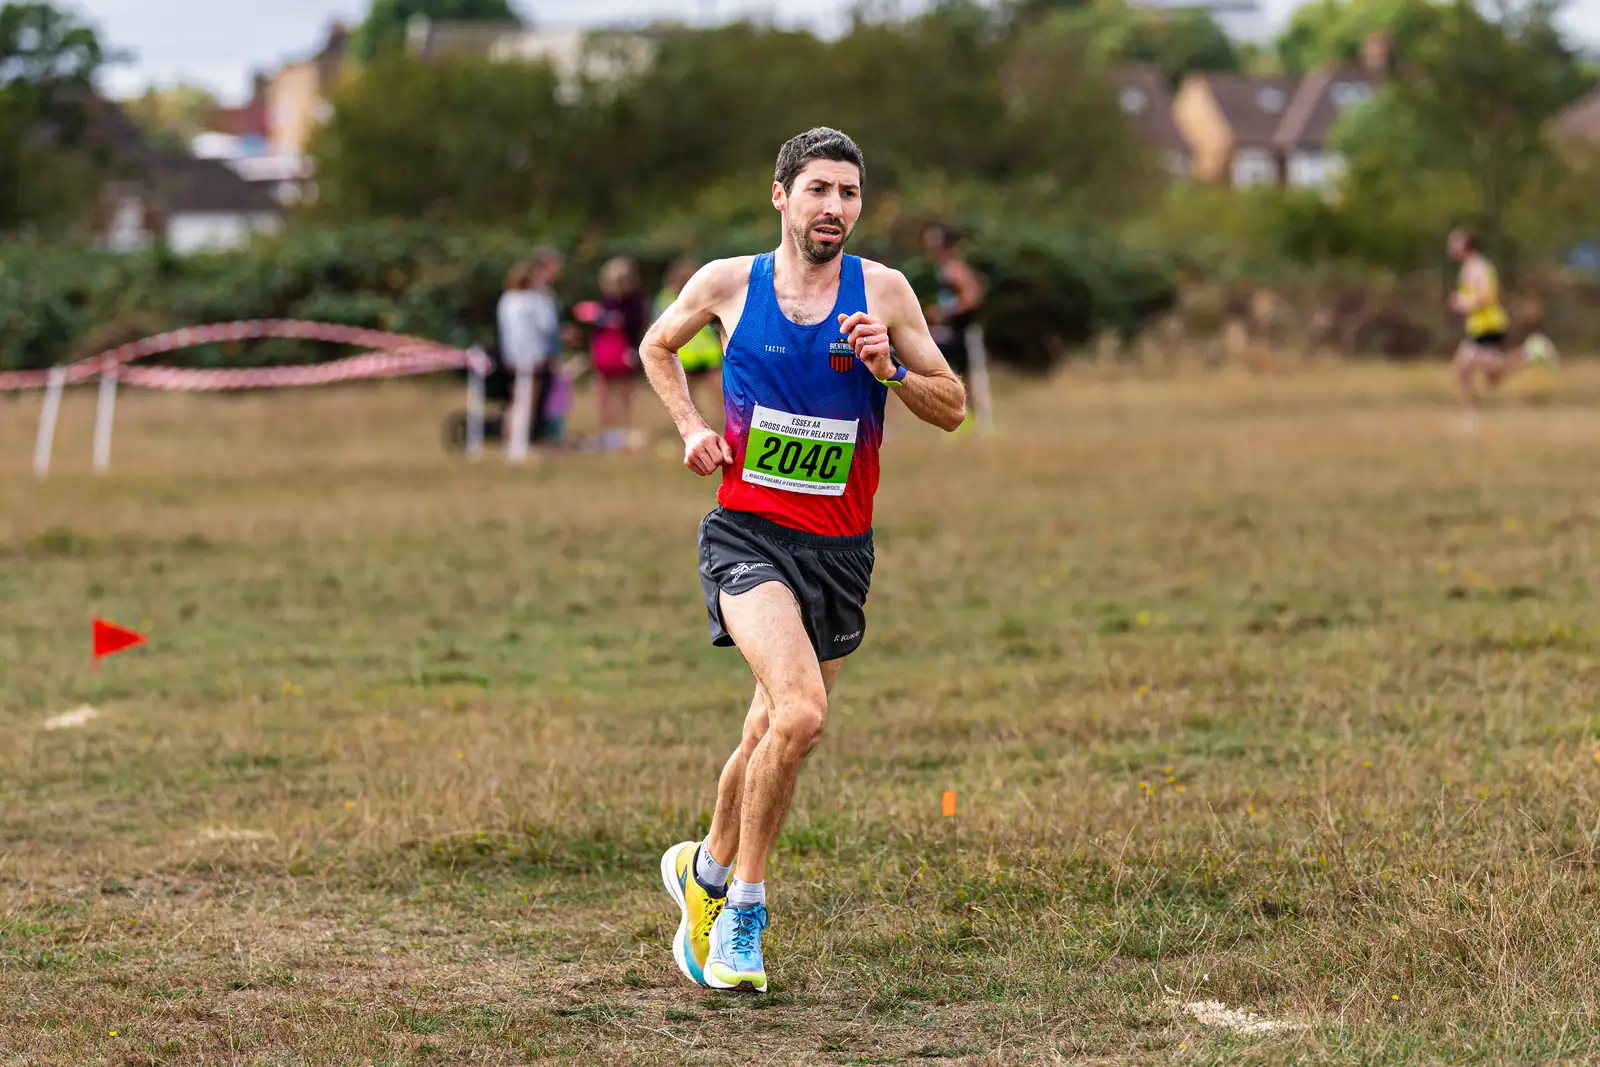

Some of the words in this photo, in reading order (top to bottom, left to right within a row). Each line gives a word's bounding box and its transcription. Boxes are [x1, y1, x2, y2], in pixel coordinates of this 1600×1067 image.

[765, 344, 786, 353] TACTIC
[760, 420, 780, 432] CROSS
[780, 425, 810, 437] COUNTRY
[810, 430, 834, 440] RELAYS
[791, 418, 811, 427] ESSEX
[812, 420, 820, 429] AA
[756, 436, 843, 479] 204C
